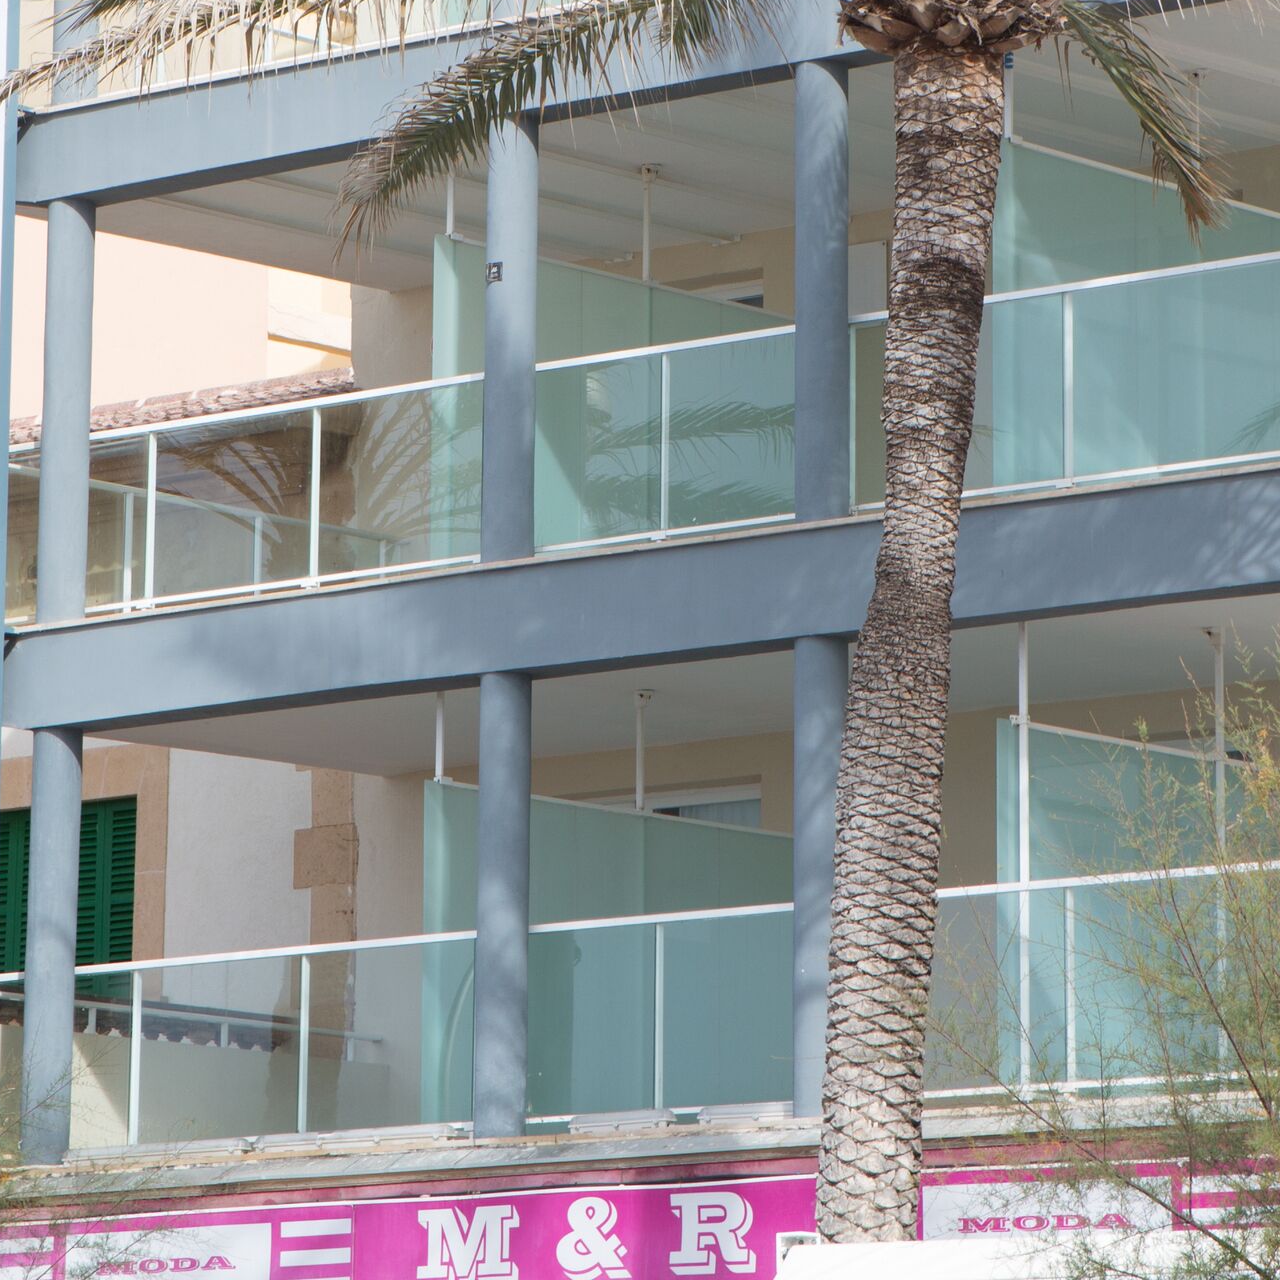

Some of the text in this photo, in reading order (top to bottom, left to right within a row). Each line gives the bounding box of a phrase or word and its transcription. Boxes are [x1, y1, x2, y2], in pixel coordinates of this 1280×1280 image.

[957, 1213, 1137, 1234] MODA
[416, 1191, 757, 1280] M & R
[95, 1255, 236, 1276] MODA
